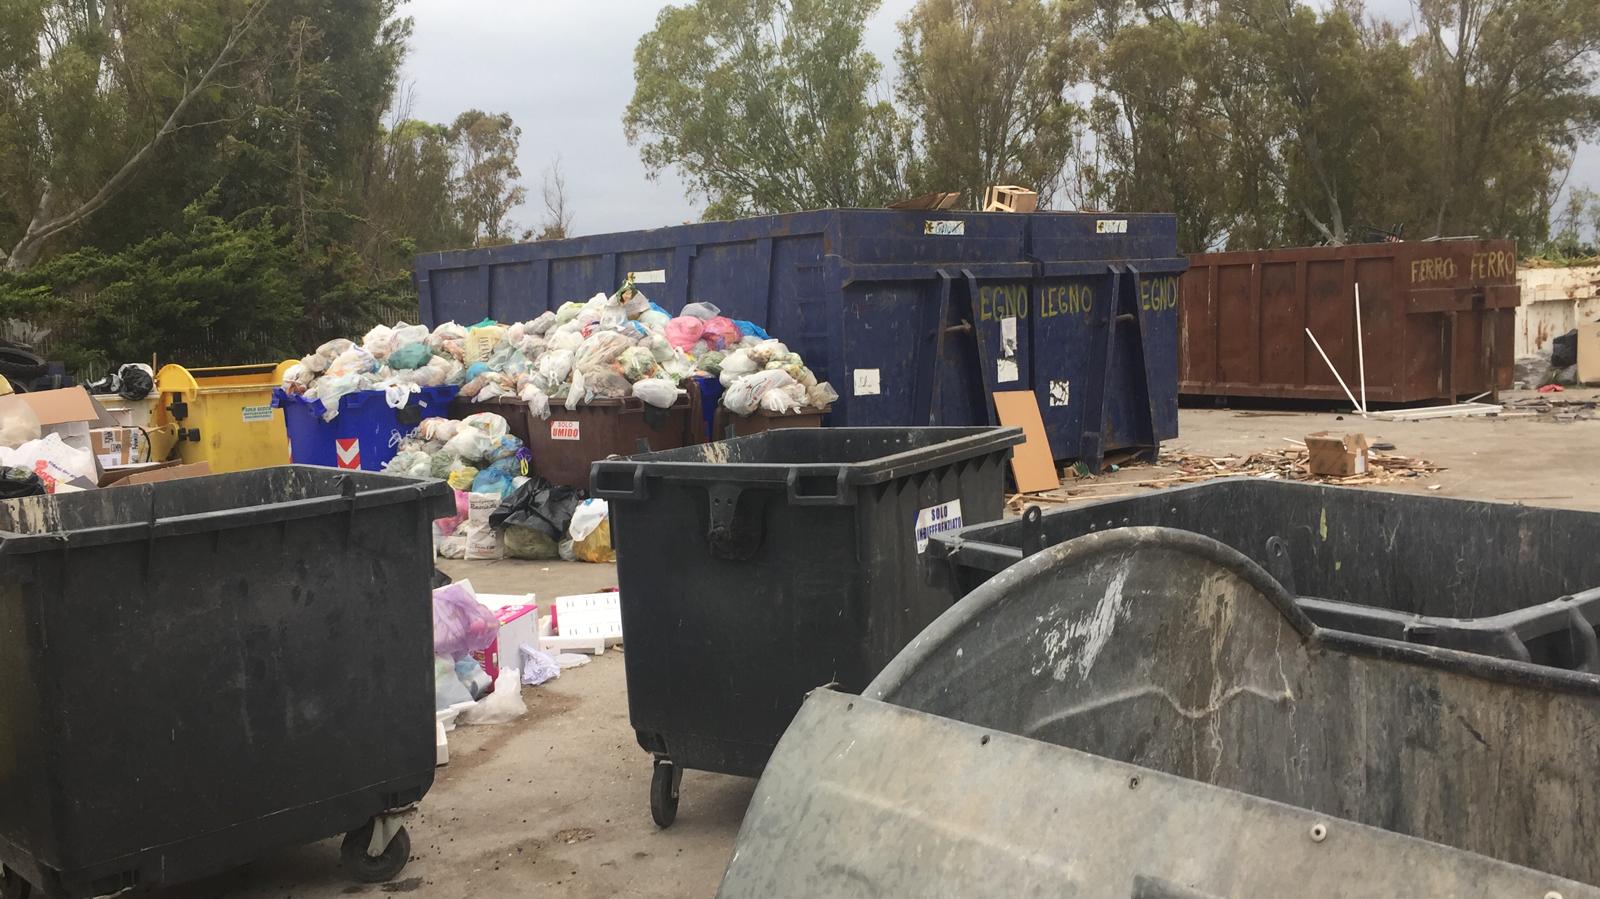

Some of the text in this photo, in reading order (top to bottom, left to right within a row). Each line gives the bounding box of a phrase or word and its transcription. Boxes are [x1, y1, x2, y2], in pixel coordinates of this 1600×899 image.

[1411, 251, 1515, 282] FERRO FERRO
[979, 285, 1028, 321] EGNO
[1041, 286, 1092, 317] LEGNO
[1140, 276, 1177, 311] EGNO
[552, 428, 578, 437] UMIDO
[931, 505, 948, 521] SOLO
